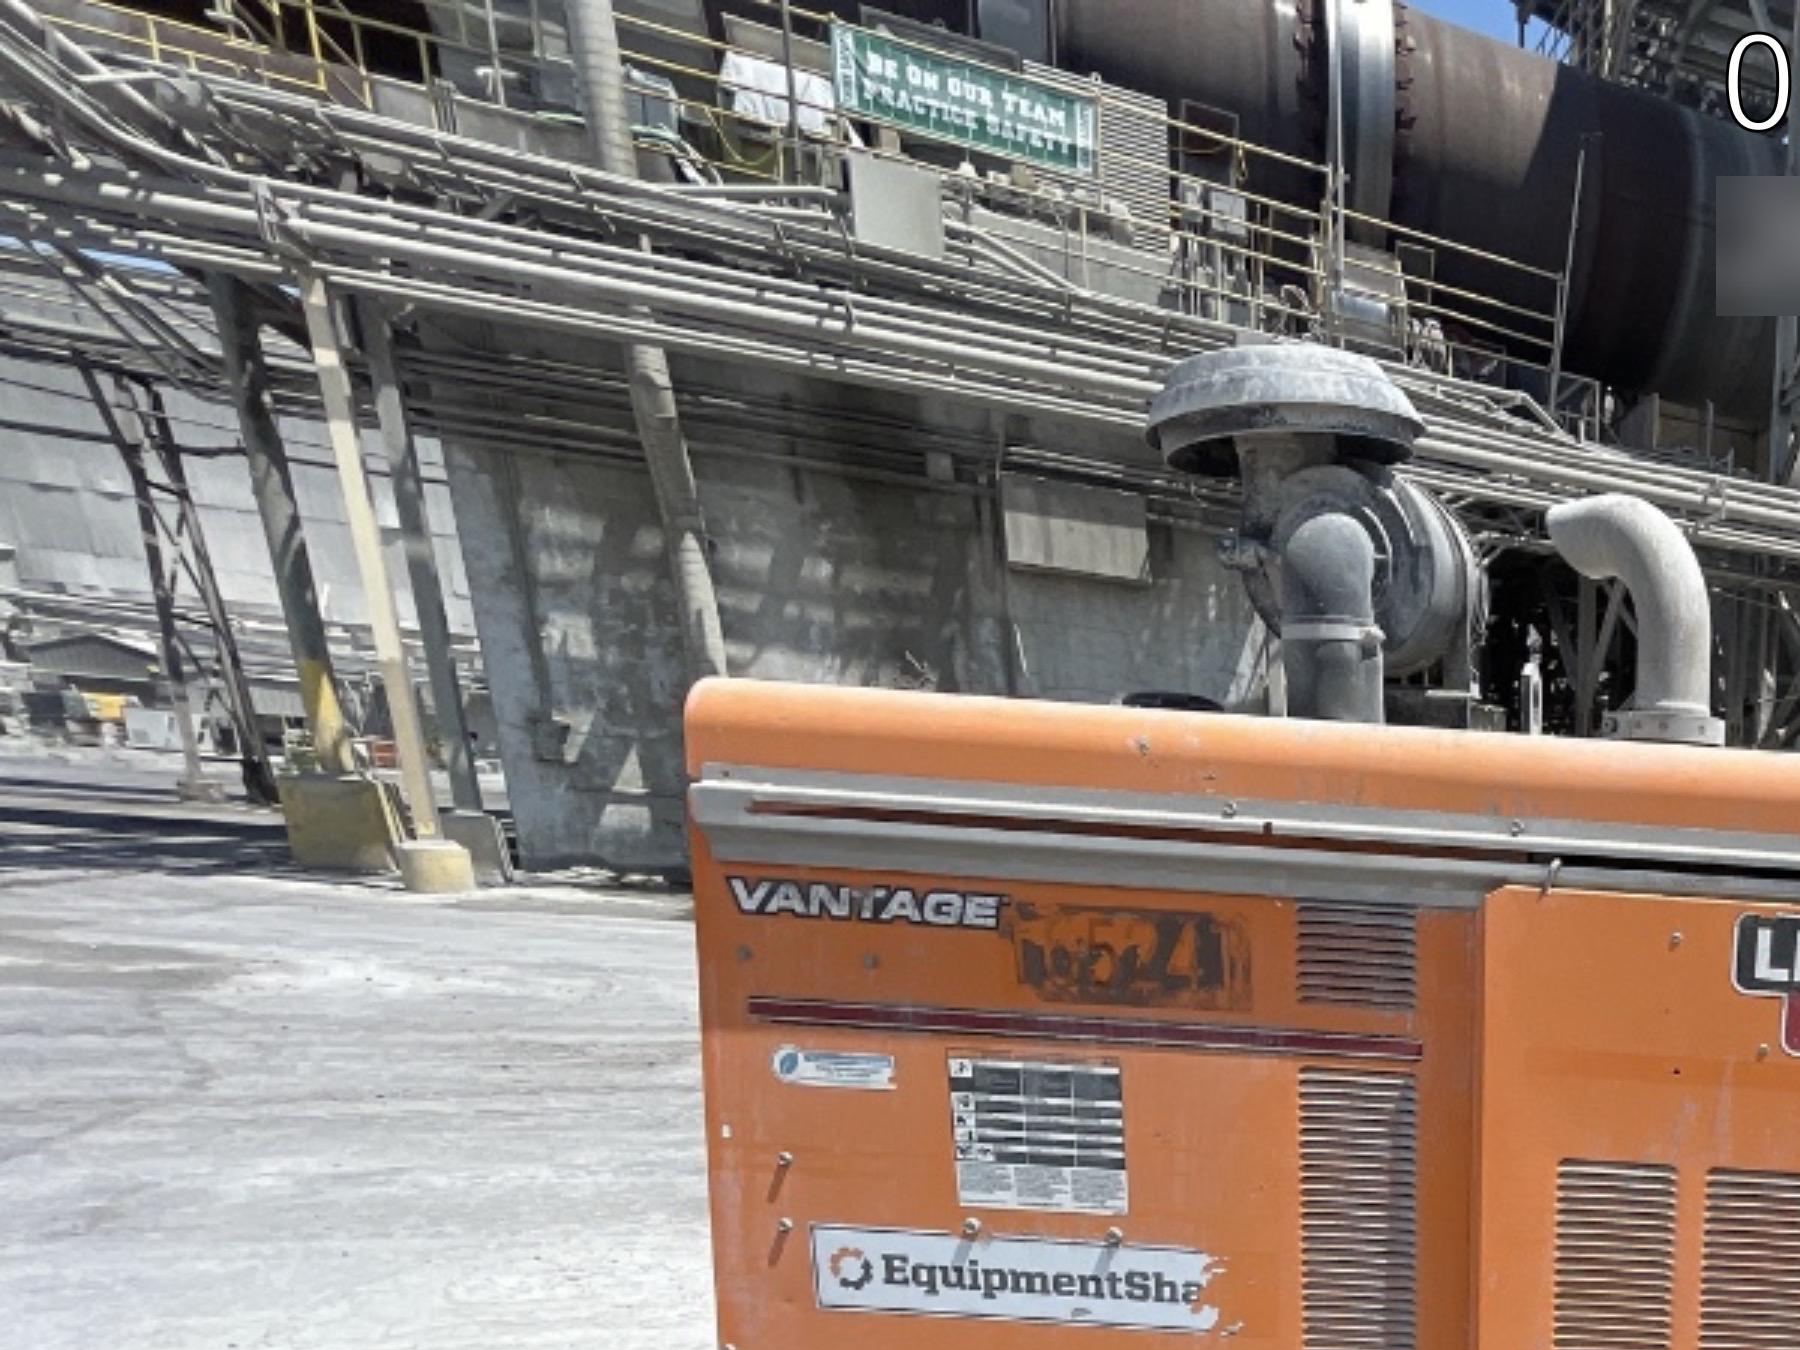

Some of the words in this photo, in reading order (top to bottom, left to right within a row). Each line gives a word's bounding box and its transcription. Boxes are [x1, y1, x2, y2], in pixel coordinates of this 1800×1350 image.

[862, 77, 980, 131] PRACTICE
[986, 113, 1074, 154] SAFETY
[907, 62, 940, 92] ON
[947, 76, 995, 108] OUR
[1002, 90, 1067, 128] TEAM
[730, 876, 1000, 929] VANTAGE
